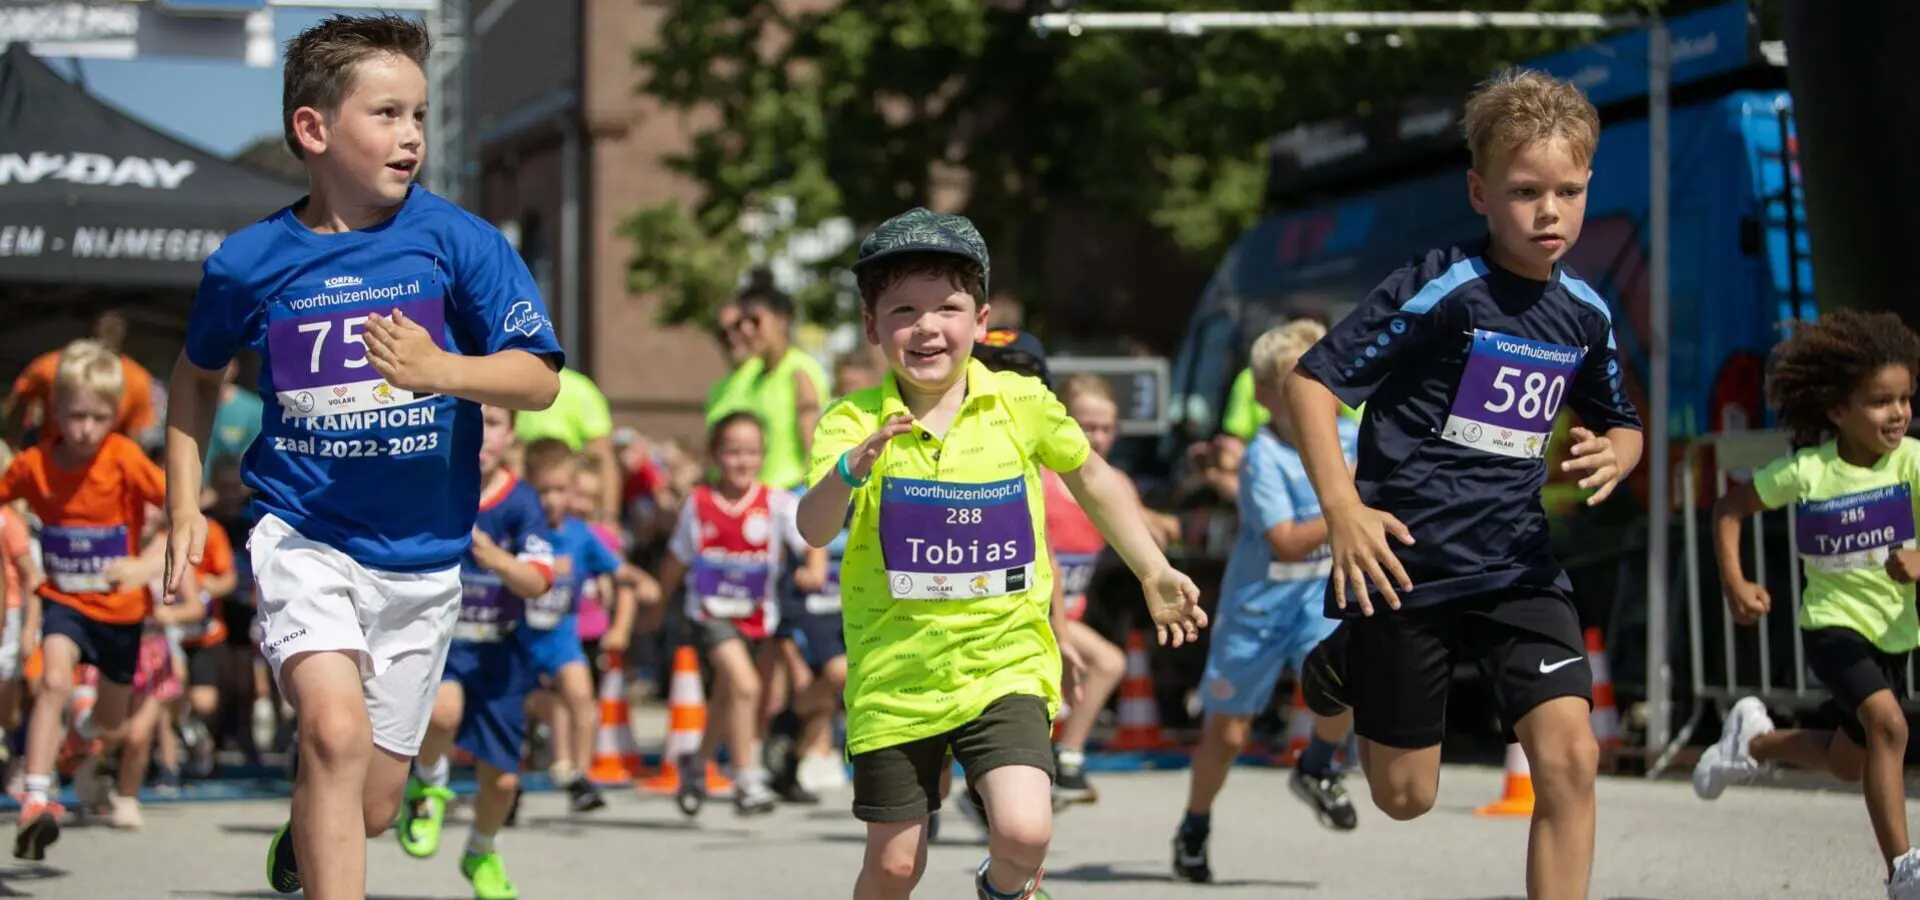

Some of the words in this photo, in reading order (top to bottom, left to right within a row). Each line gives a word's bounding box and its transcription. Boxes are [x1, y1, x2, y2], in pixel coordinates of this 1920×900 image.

[290, 280, 420, 311] voorthuizenloopt.nl
[298, 310, 403, 374] 75
[1496, 340, 1577, 365] voorthuizenloopt.nl
[1484, 366, 1566, 421] 580
[306, 405, 436, 431] KAMPIOEN
[275, 436, 315, 455] zaal
[320, 432, 438, 458] 2022-2023
[904, 482, 1022, 500] voorthuizenloopt.nl
[946, 508, 982, 524] 288
[906, 538, 1017, 565] Tobias
[1815, 525, 1895, 555] Tyrone
